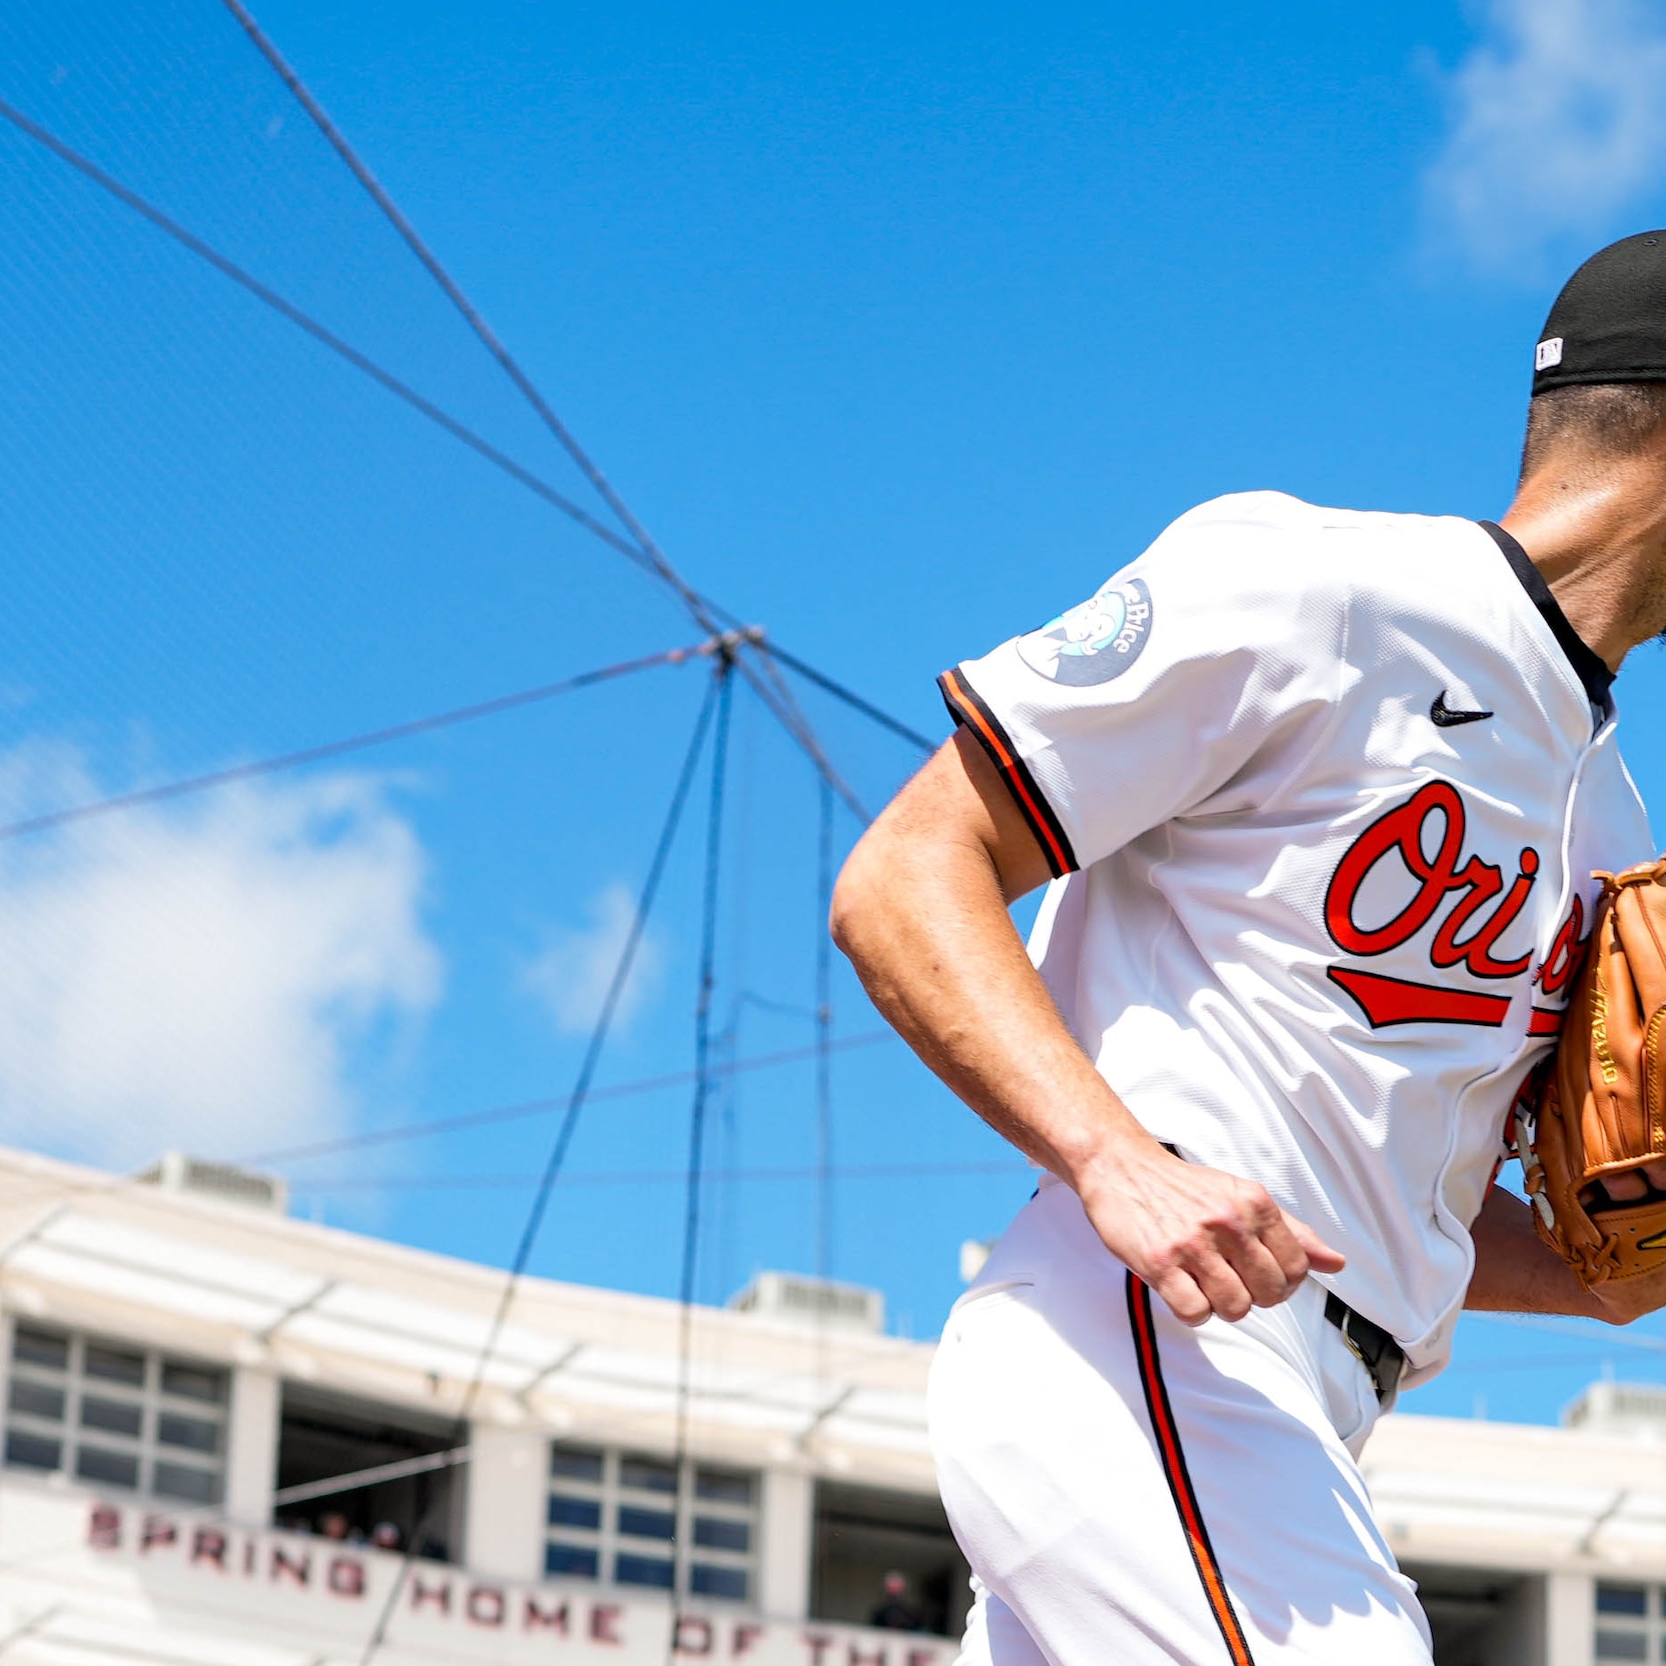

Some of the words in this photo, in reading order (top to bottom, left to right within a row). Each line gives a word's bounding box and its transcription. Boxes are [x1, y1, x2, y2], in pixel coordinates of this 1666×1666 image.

[1324, 779, 1593, 995] Orio
[88, 1501, 367, 1600] SPRING
[410, 1570, 625, 1647] HOME
[674, 1615, 763, 1662] OF
